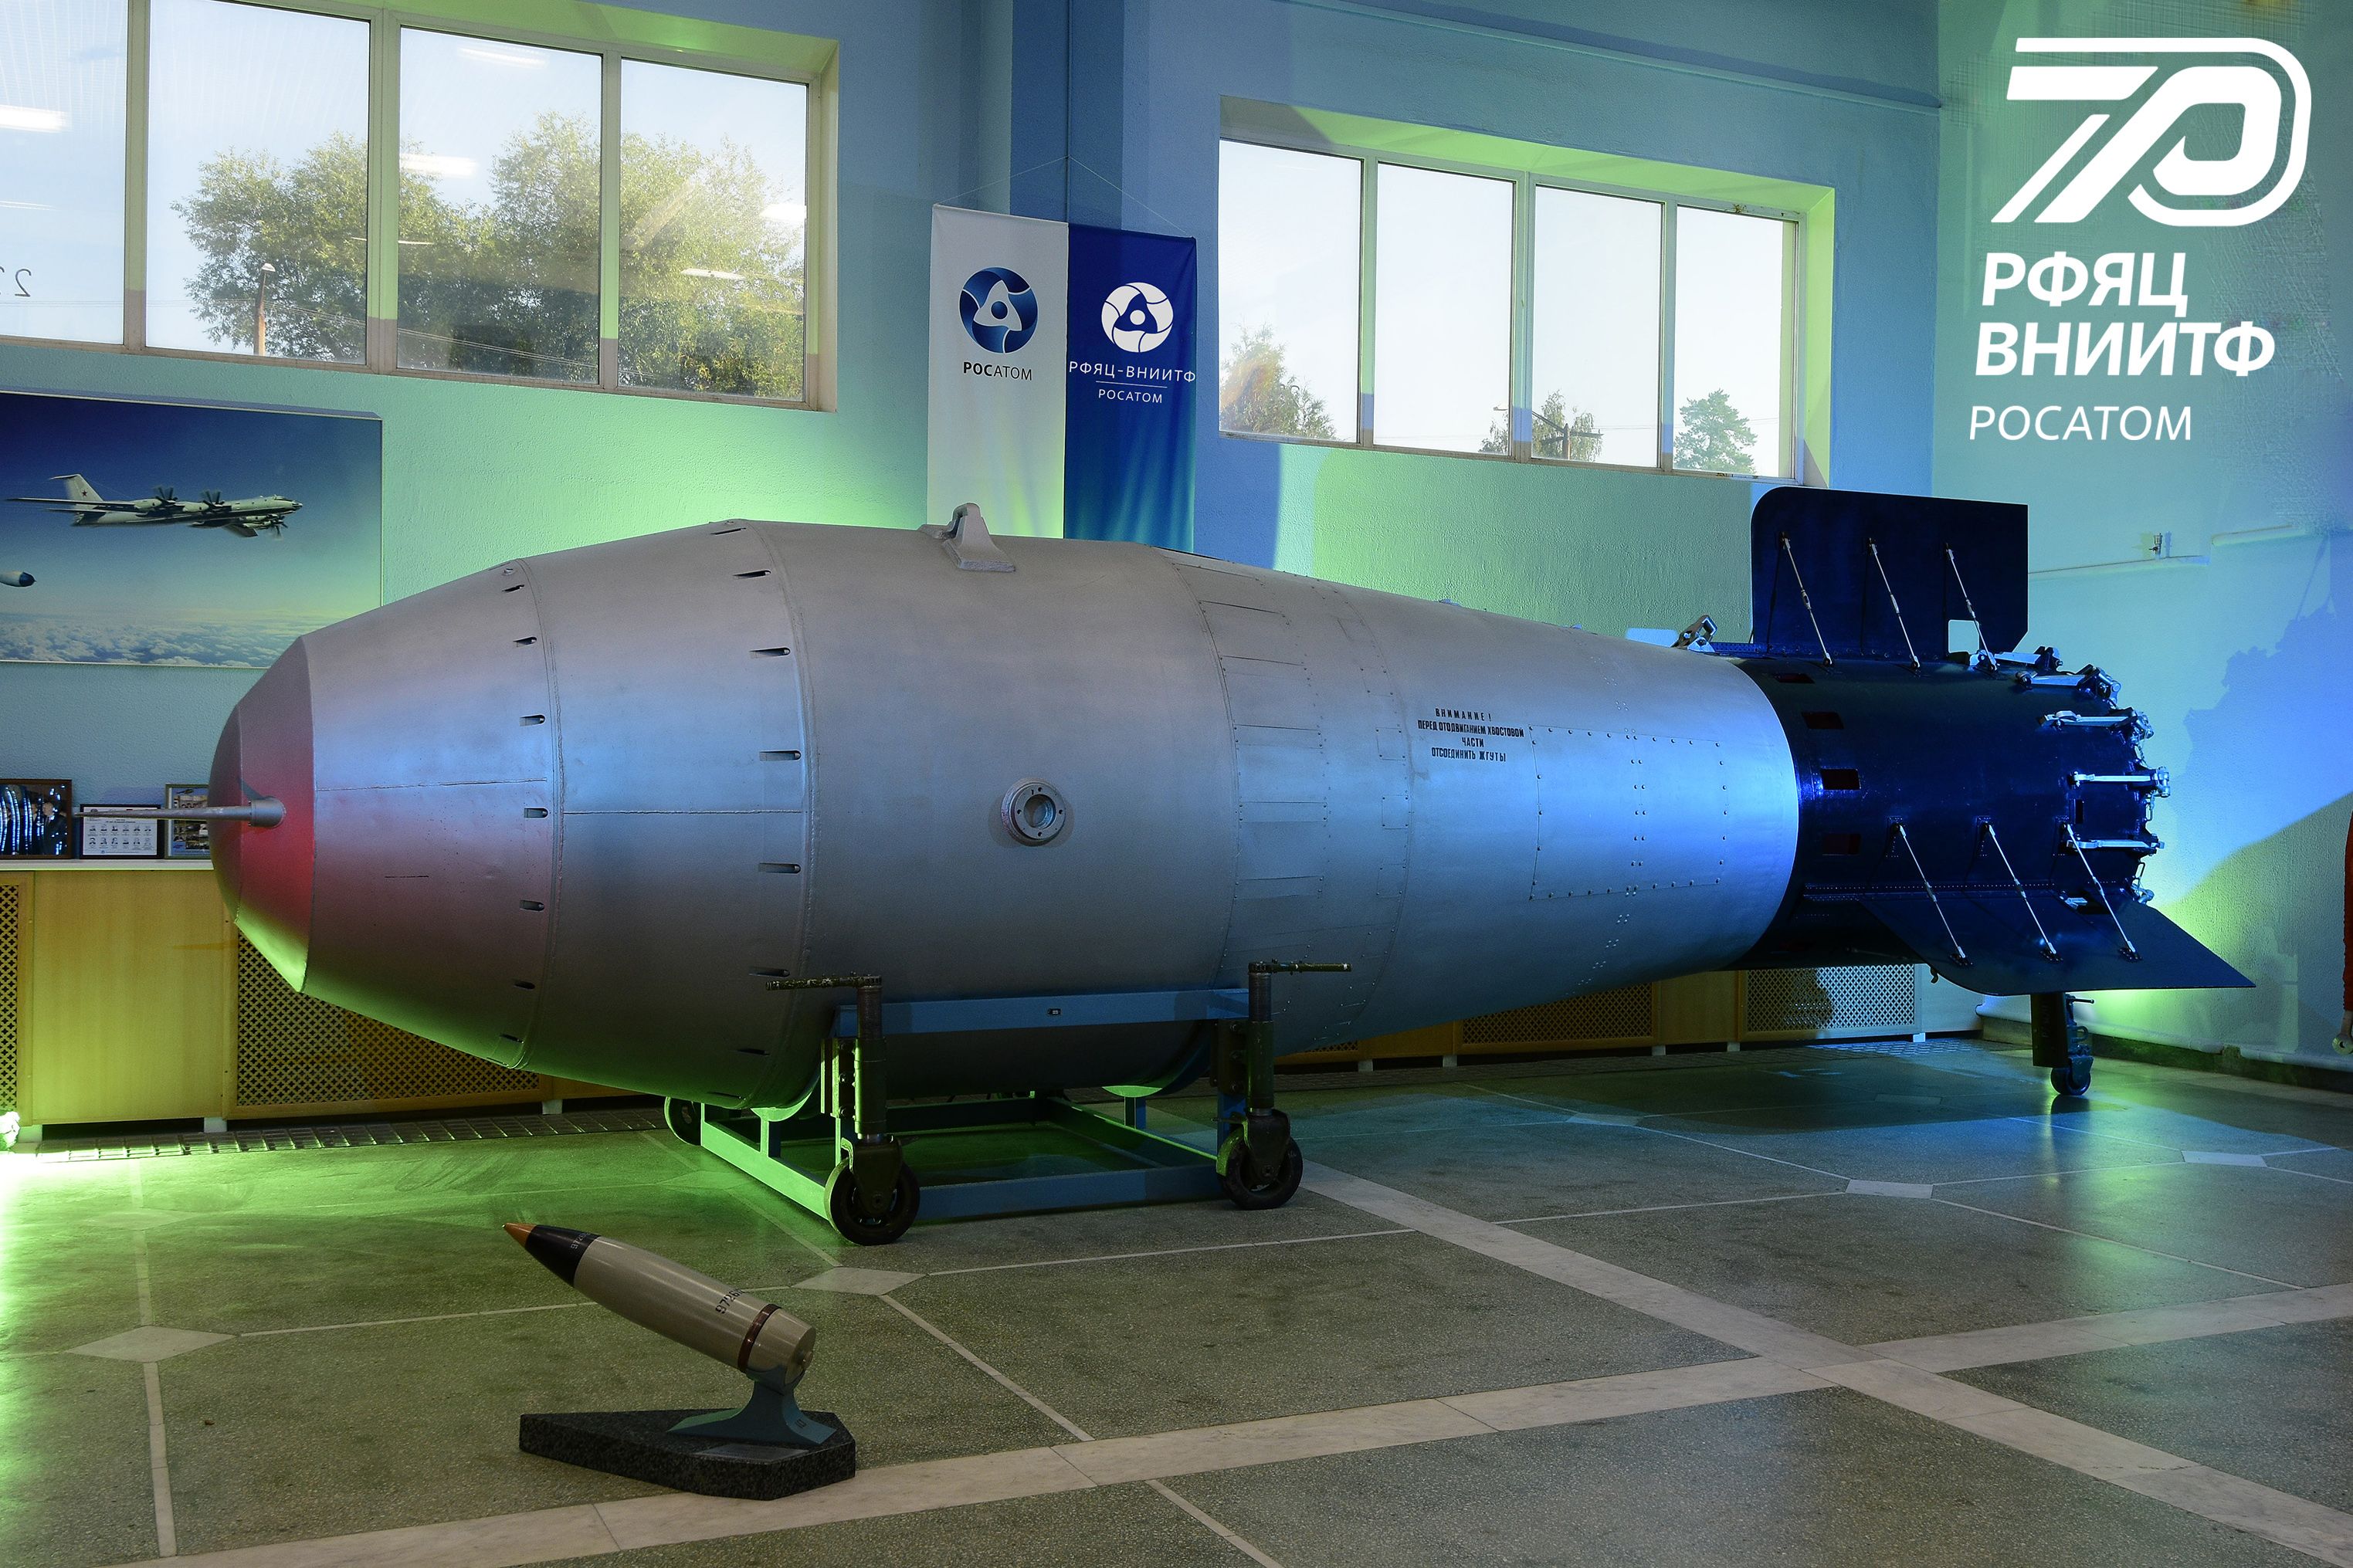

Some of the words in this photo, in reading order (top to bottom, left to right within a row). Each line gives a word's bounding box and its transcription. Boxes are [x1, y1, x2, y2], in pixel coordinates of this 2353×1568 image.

[963, 361, 1032, 381] РОСАТОМ
[1069, 361, 1196, 383] РФЯЦ-ВНИИТФ
[1097, 389, 1163, 404] РОСАТОМ
[1417, 720, 1438, 731] ПЕРЕД
[1439, 723, 1487, 735] ОТОДВИГАНИЕМ
[1487, 727, 1524, 738] ХВОСТОВОЙ
[1461, 737, 1484, 748] ЧАСТИ
[1431, 747, 1476, 760] ОТСОЕДИНИТЬ
[1479, 750, 1506, 762] ЖГУТЫ
